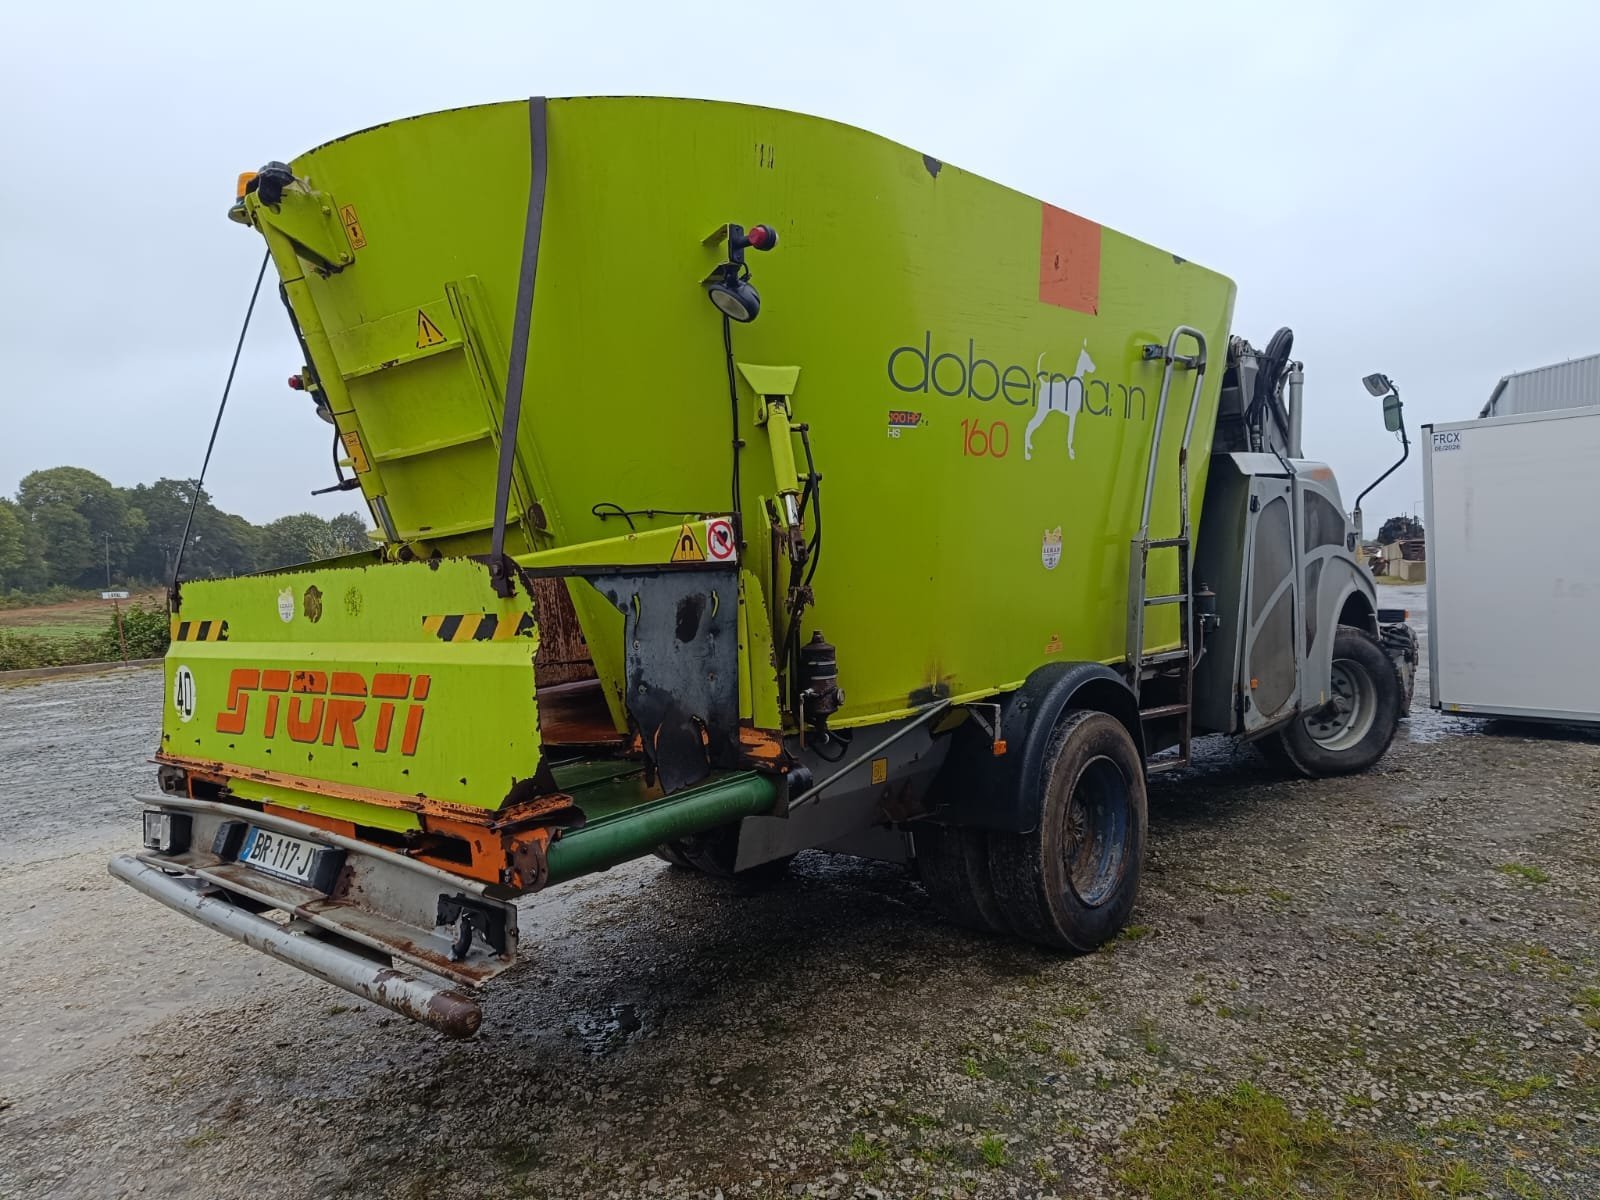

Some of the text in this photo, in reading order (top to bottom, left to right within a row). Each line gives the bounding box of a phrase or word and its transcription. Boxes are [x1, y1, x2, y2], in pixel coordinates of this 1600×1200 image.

[887, 330, 1146, 421] dobermann
[887, 428, 900, 438] HS
[907, 411, 920, 423] HP
[961, 418, 1009, 459] 160
[1433, 432, 1460, 445] FRCX
[176, 671, 192, 717] 40
[250, 832, 317, 876] BR-117-J
